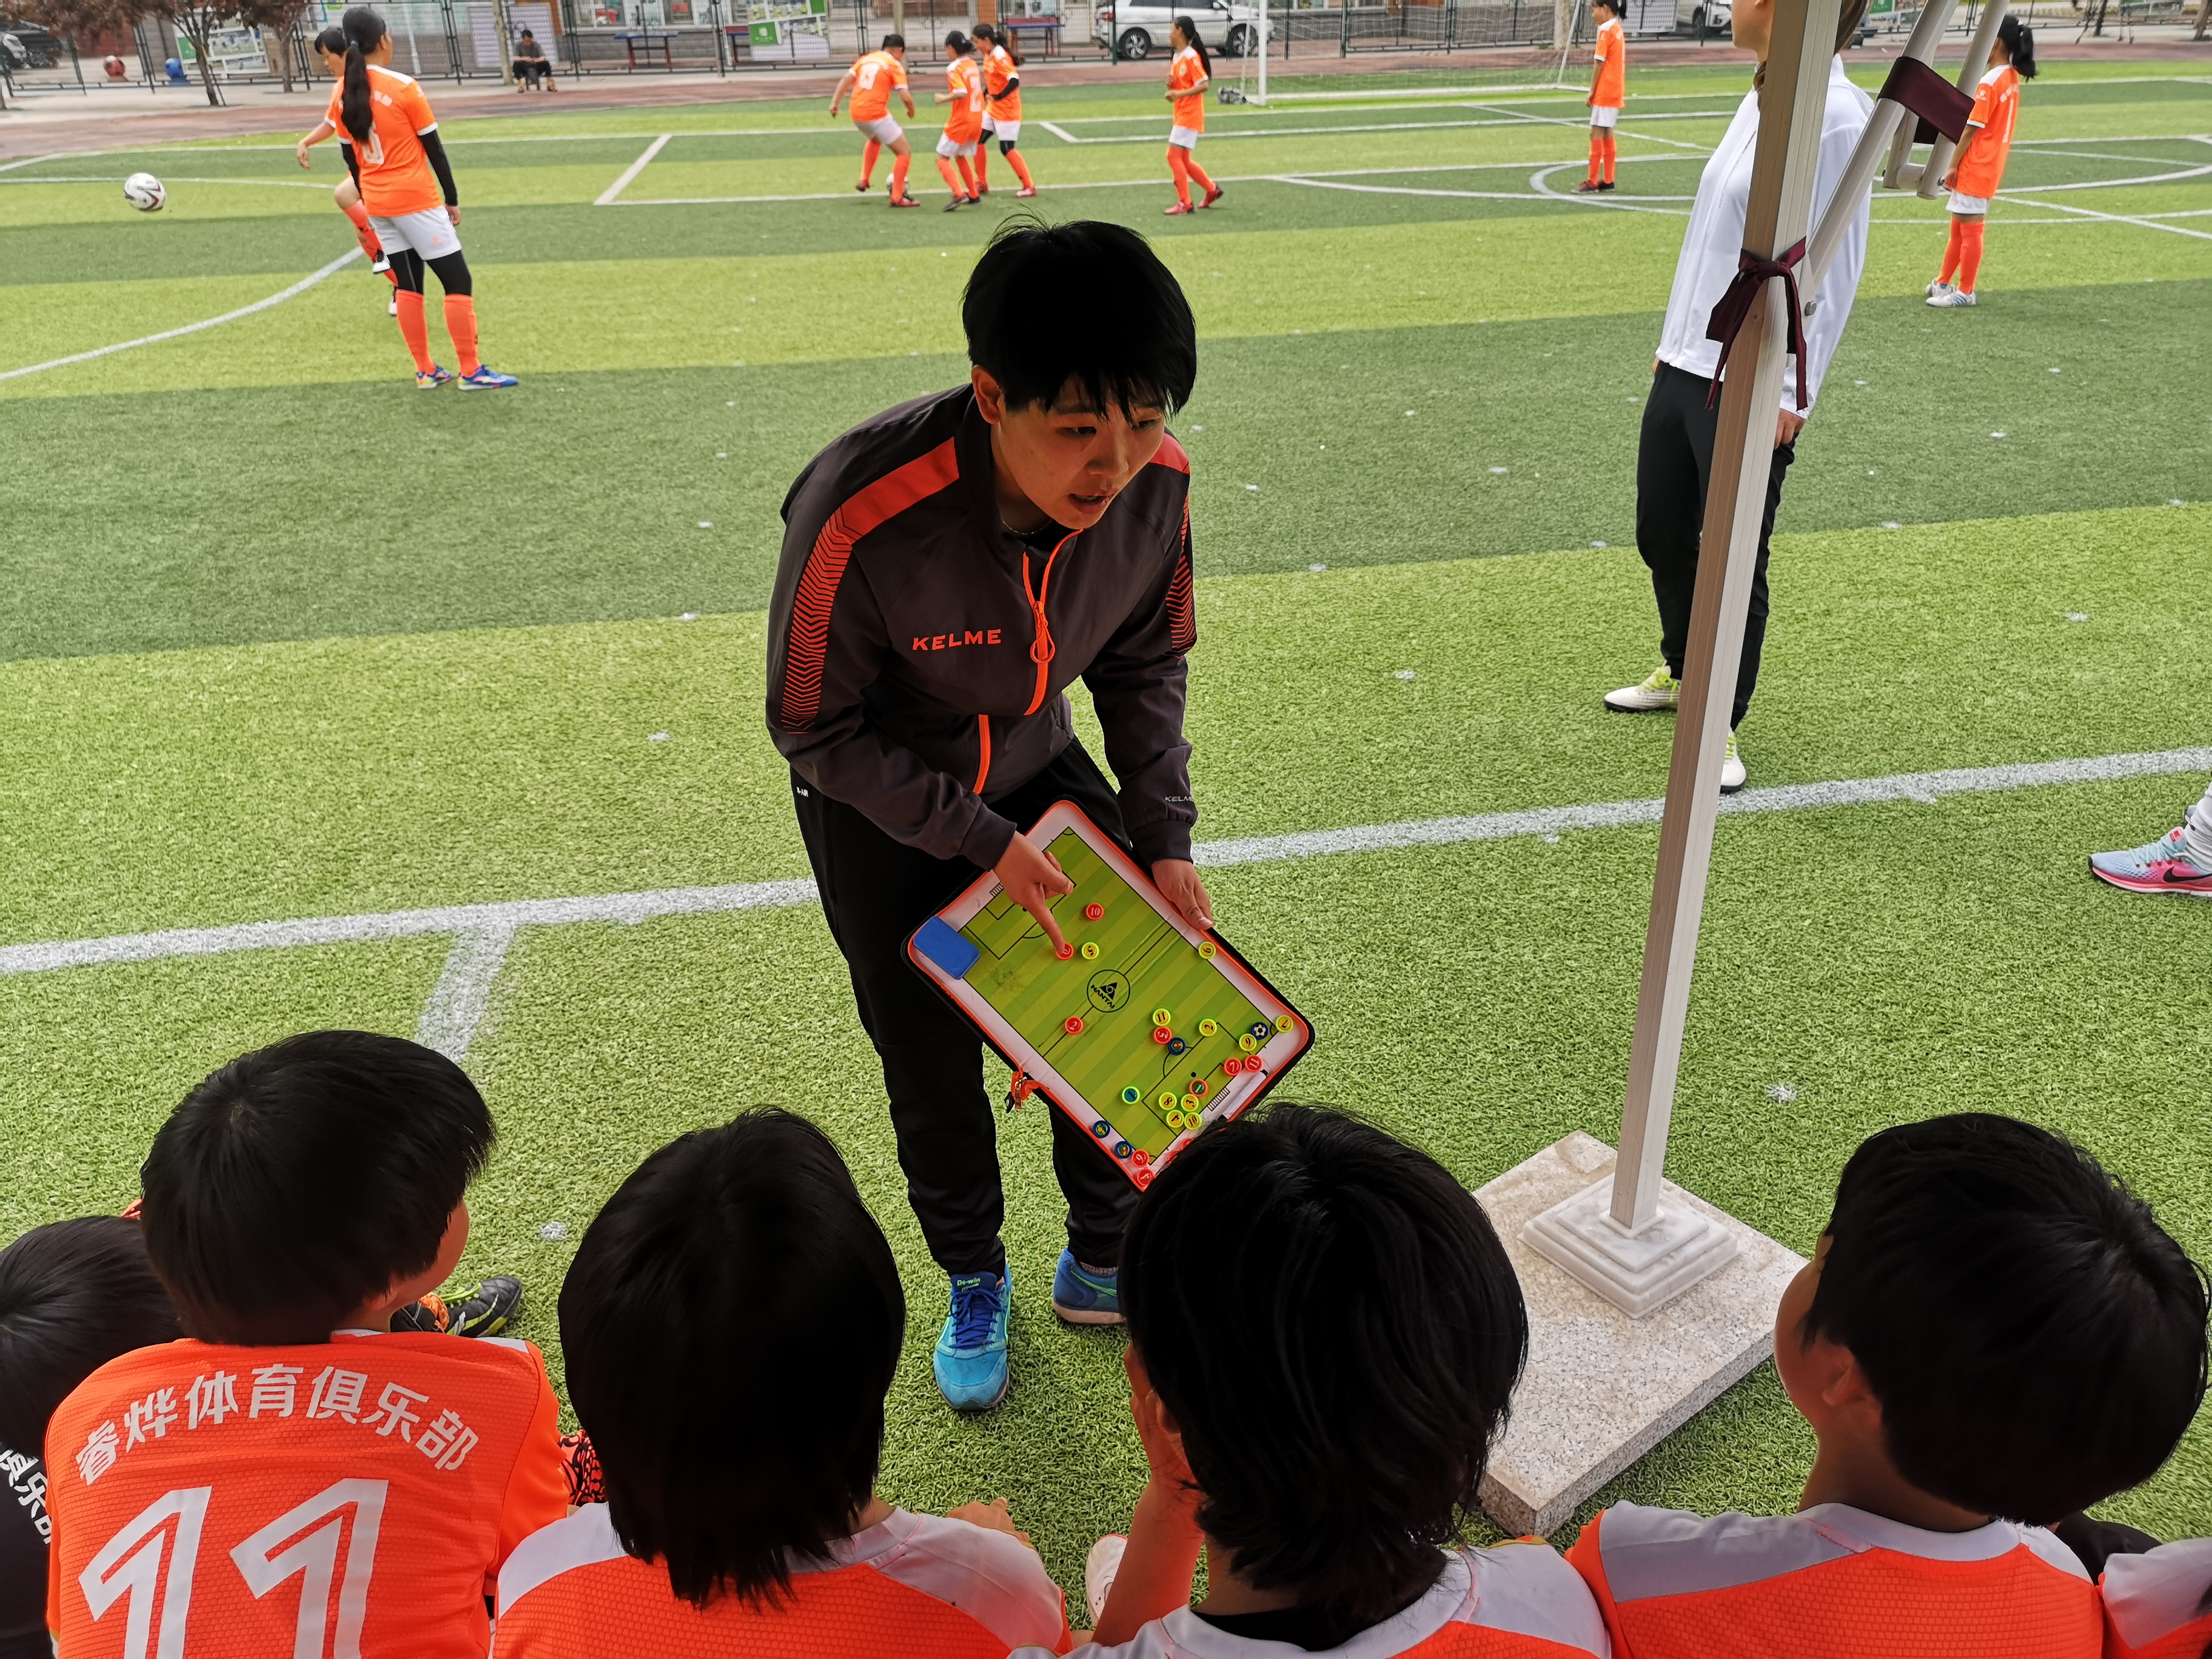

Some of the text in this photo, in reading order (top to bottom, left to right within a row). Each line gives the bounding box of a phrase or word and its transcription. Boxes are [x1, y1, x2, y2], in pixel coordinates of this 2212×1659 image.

[913, 629, 1002, 651] KELME
[1091, 907, 1101, 916] 10
[1157, 1012, 1165, 1022] 11
[1069, 1021, 1078, 1030] 2
[1249, 1057, 1259, 1068] 11
[1195, 1084, 1202, 1093] 1
[1164, 1097, 1173, 1105] 8
[1188, 1115, 1198, 1127] 10
[76, 1363, 479, 1486] 睿烨体育俱乐部
[79, 1478, 389, 1659] 11
